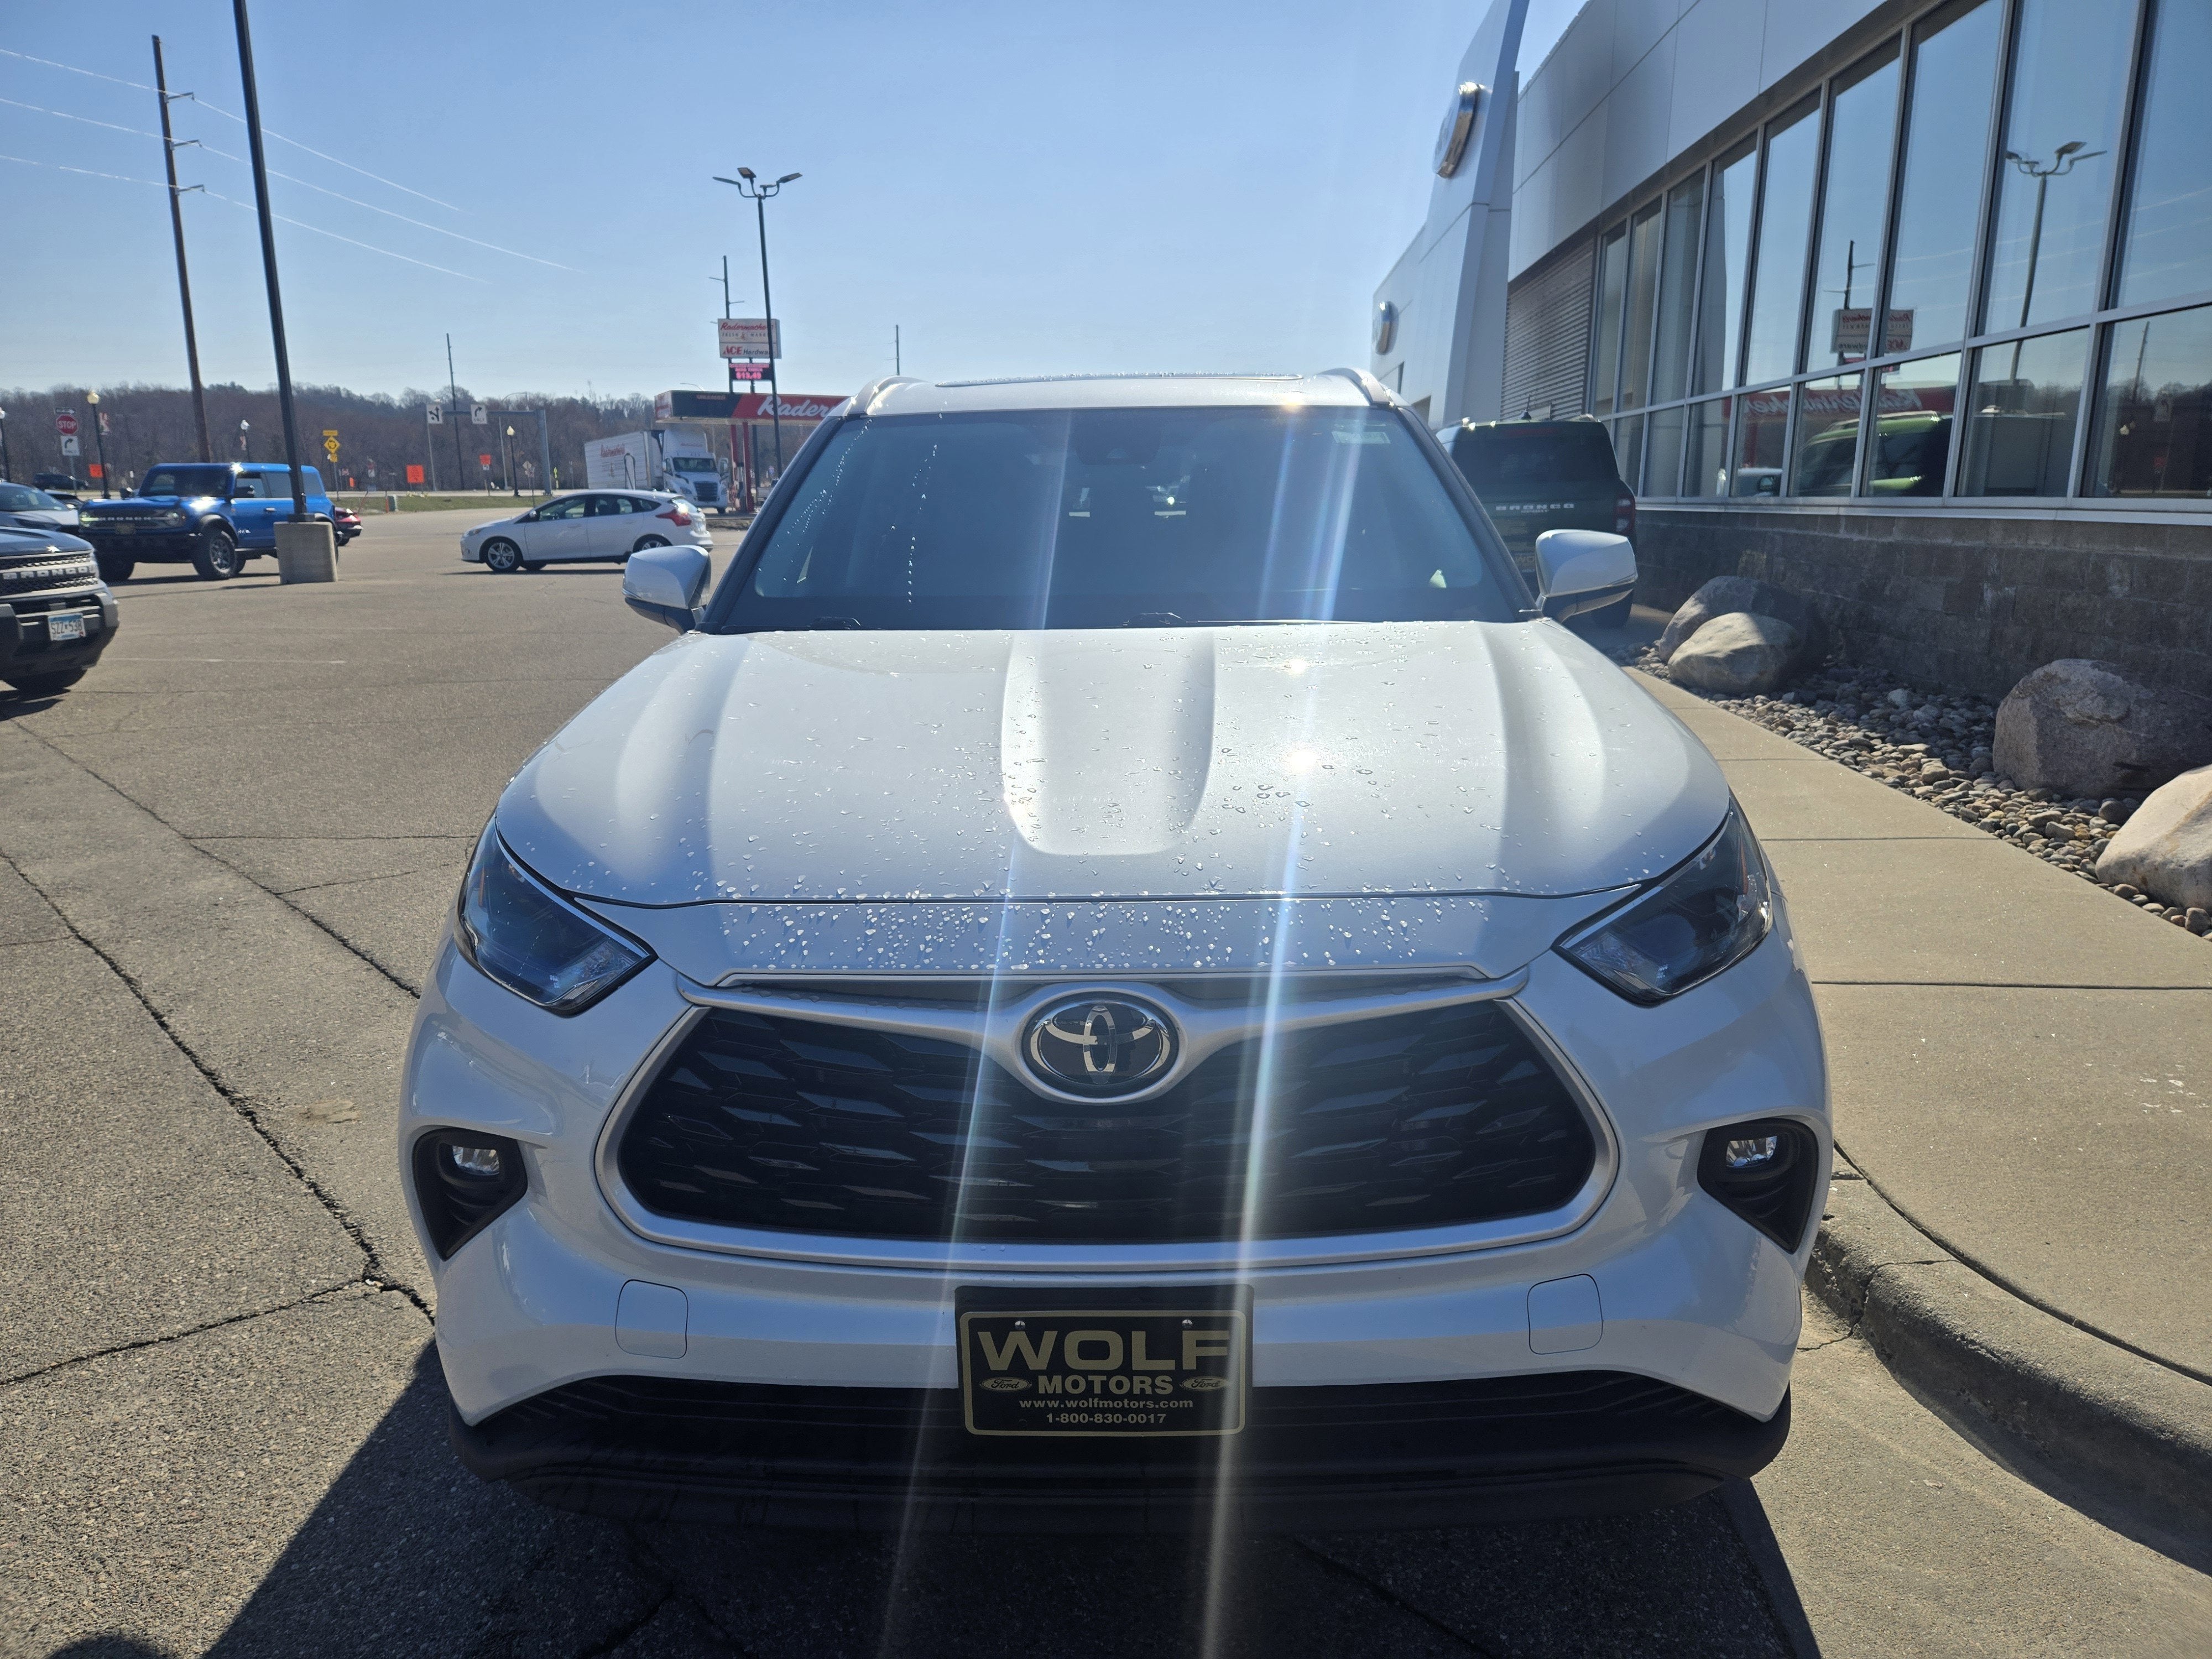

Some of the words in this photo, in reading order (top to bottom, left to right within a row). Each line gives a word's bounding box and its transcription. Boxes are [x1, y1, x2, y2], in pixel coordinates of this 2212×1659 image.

[722, 345, 742, 354] ACE
[58, 420, 76, 429] STOP
[977, 1330, 1231, 1370] WOLF
[990, 1379, 1020, 1389] Ford
[1038, 1375, 1173, 1395] MOTORS
[1191, 1379, 1221, 1388] Ford
[1019, 1398, 1193, 1408] www.wolfmotors.com
[1046, 1412, 1166, 1423] 1-800-830-0017
